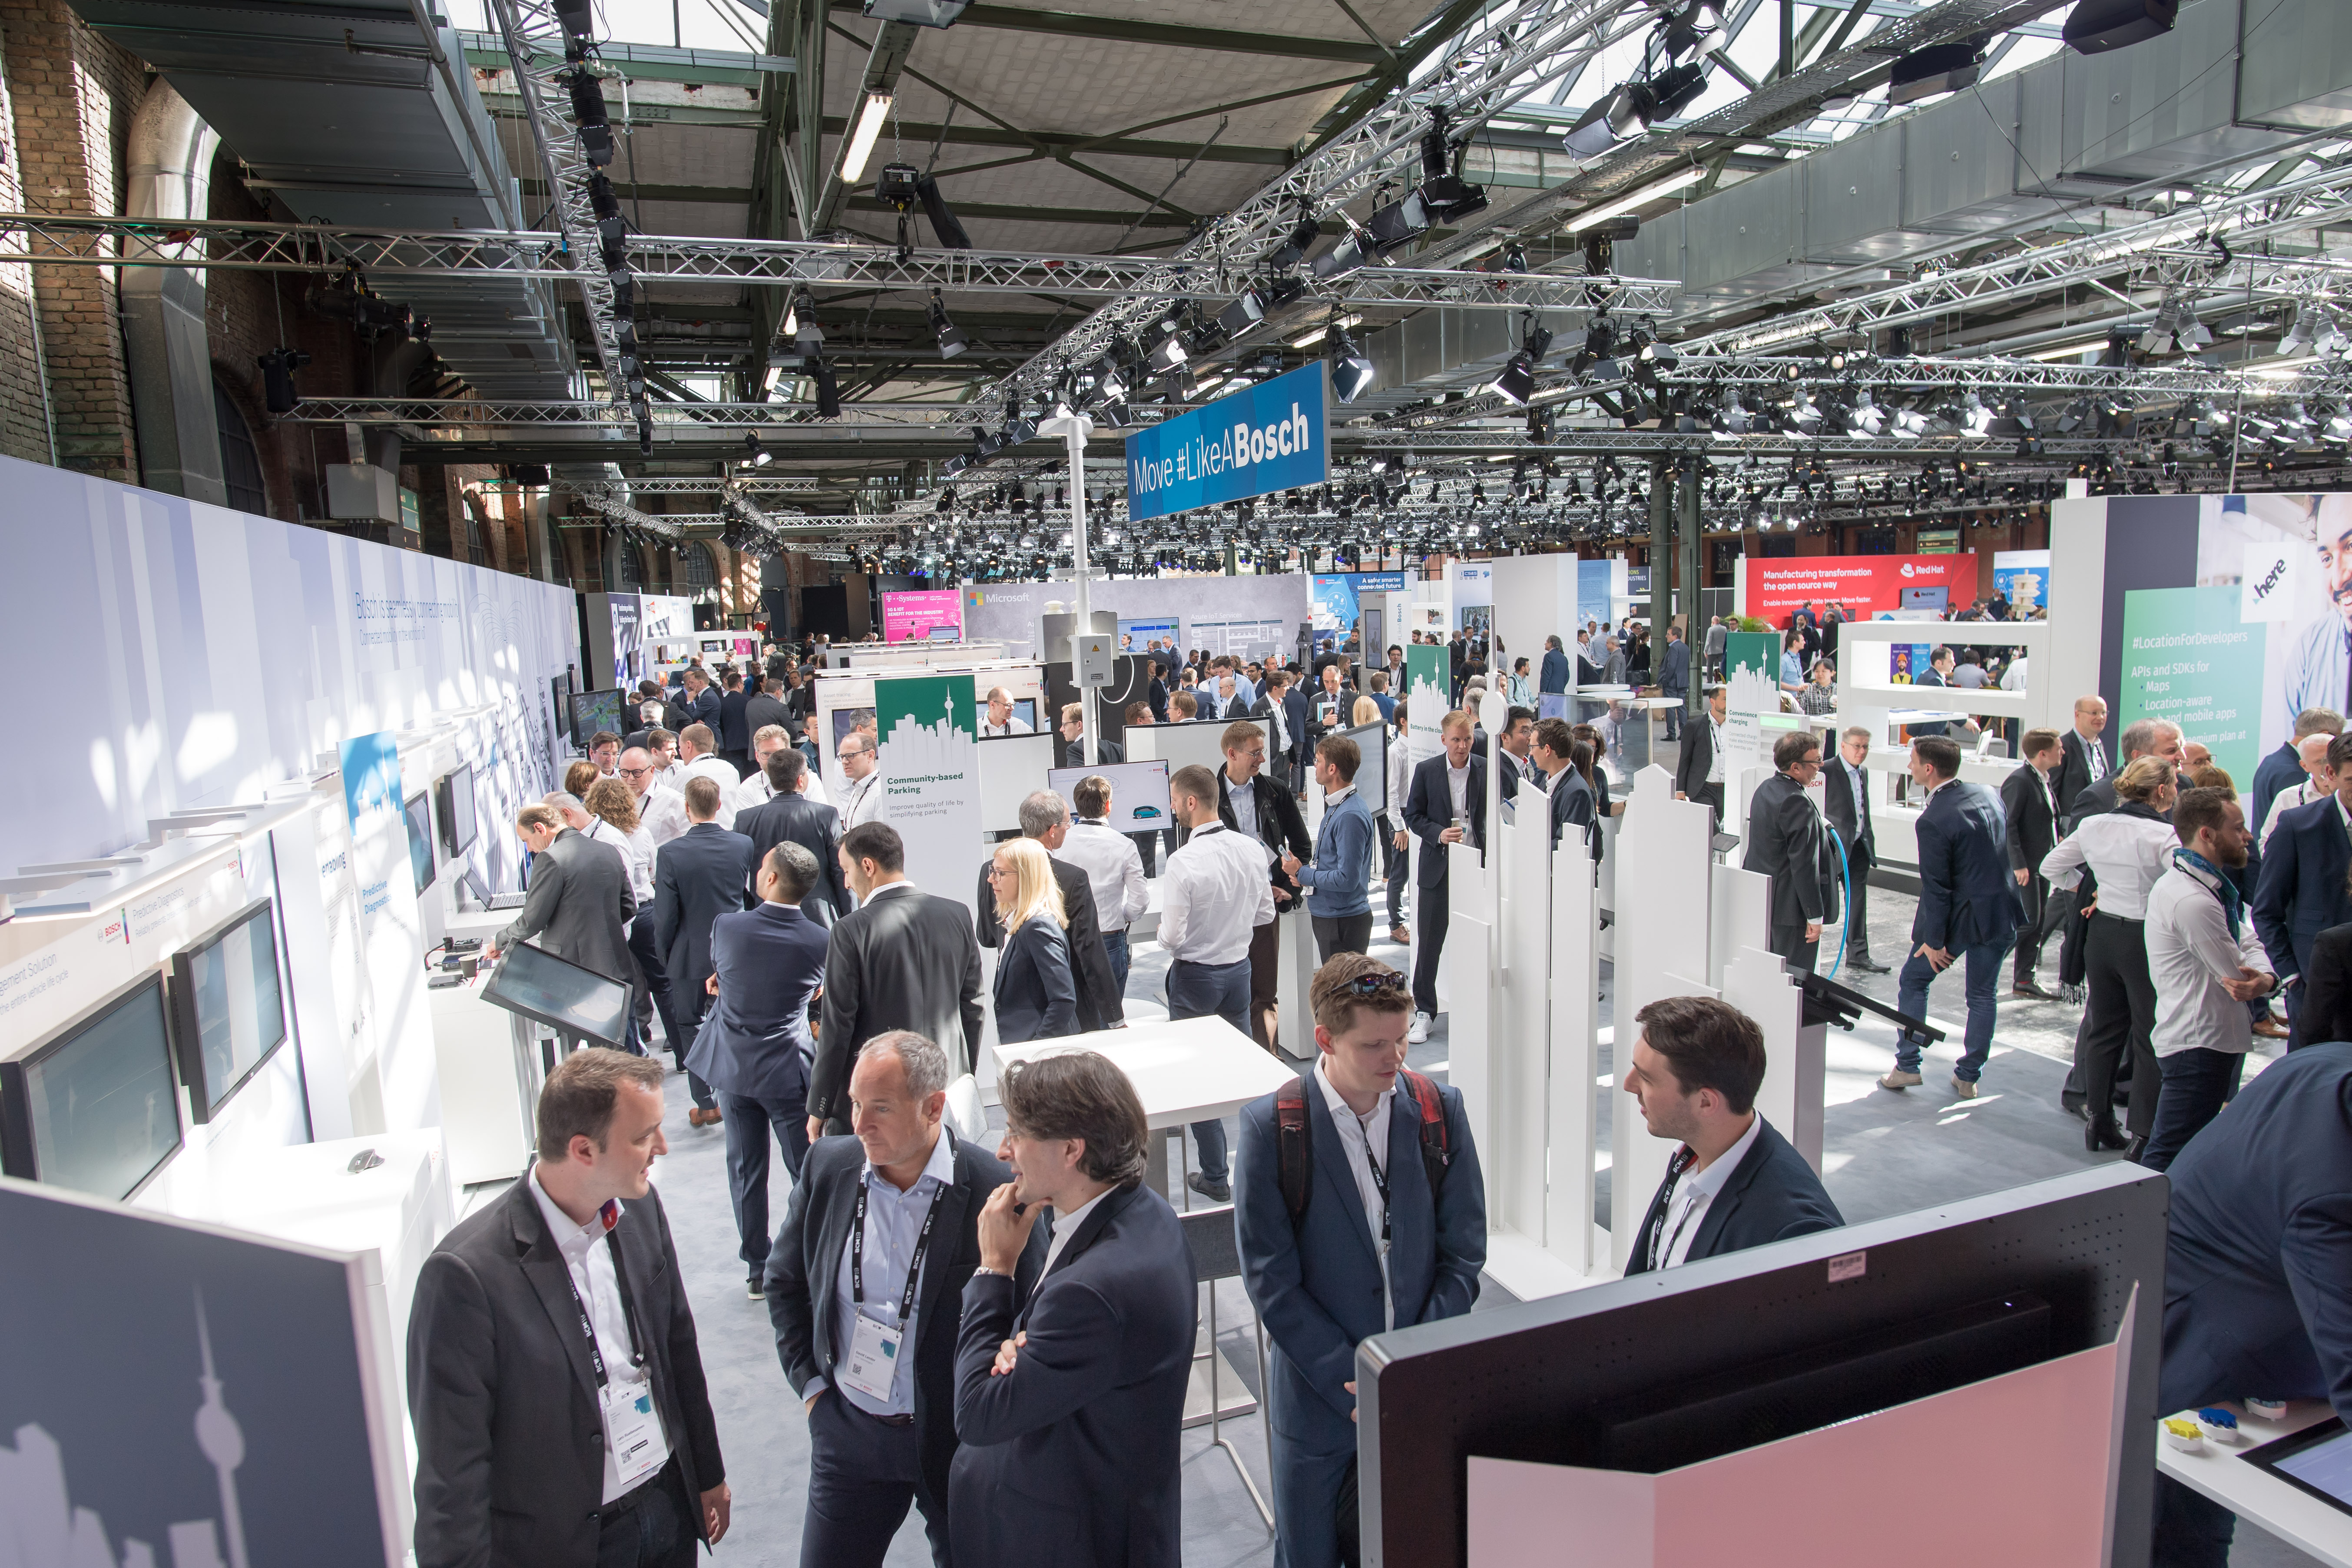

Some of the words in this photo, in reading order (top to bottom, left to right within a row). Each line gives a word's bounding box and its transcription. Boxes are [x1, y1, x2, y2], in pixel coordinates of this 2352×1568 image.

[1135, 457, 1173, 495] Move
[1177, 402, 1309, 481] #LikeABosch
[1763, 570, 1817, 579] Manufacturing
[1819, 568, 1872, 577] transformation
[1916, 566, 1930, 574] Red
[1931, 565, 1944, 573] Hat
[1763, 582, 1776, 590] the
[1777, 583, 1796, 592] open
[1822, 581, 1837, 590] way
[2254, 559, 2286, 599] here
[986, 593, 1030, 603] Microsoft
[355, 592, 377, 619] Bosch
[386, 593, 416, 623] seamlessly
[2133, 630, 2248, 650] #LocationForDevelopers
[2131, 666, 2151, 678] APIs
[2153, 663, 2170, 676] and
[2173, 662, 2195, 674] SDKs
[2197, 660, 2210, 672] for
[2146, 681, 2170, 694] Maps
[2146, 696, 2212, 711] Location-aware
[1729, 709, 1757, 718] Convenience
[2184, 709, 2213, 723] mobile
[2216, 709, 2236, 722] apps
[1729, 718, 1748, 726] charging
[2184, 733, 2217, 743] reemium
[2219, 730, 2236, 743] plan
[2238, 730, 2246, 739] at
[887, 772, 963, 784] Community-based
[888, 786, 921, 795] Parking
[890, 810, 923, 819] simplifying
[363, 880, 388, 899] Predictive
[133, 901, 158, 921] Predictive
[157, 887, 184, 908] Diagnostics
[365, 893, 392, 915] Diagnostics
[105, 921, 121, 937] BOSCH
[0, 968, 27, 996] gement
[28, 954, 57, 977] Solution
[11, 994, 27, 1009] entire
[27, 981, 46, 999] vehicle
[1663, 1183, 1673, 1204] BCW19
[923, 1214, 934, 1235] BCW19
[904, 1283, 914, 1304] BCW19
[873, 1324, 886, 1332] BCW19
